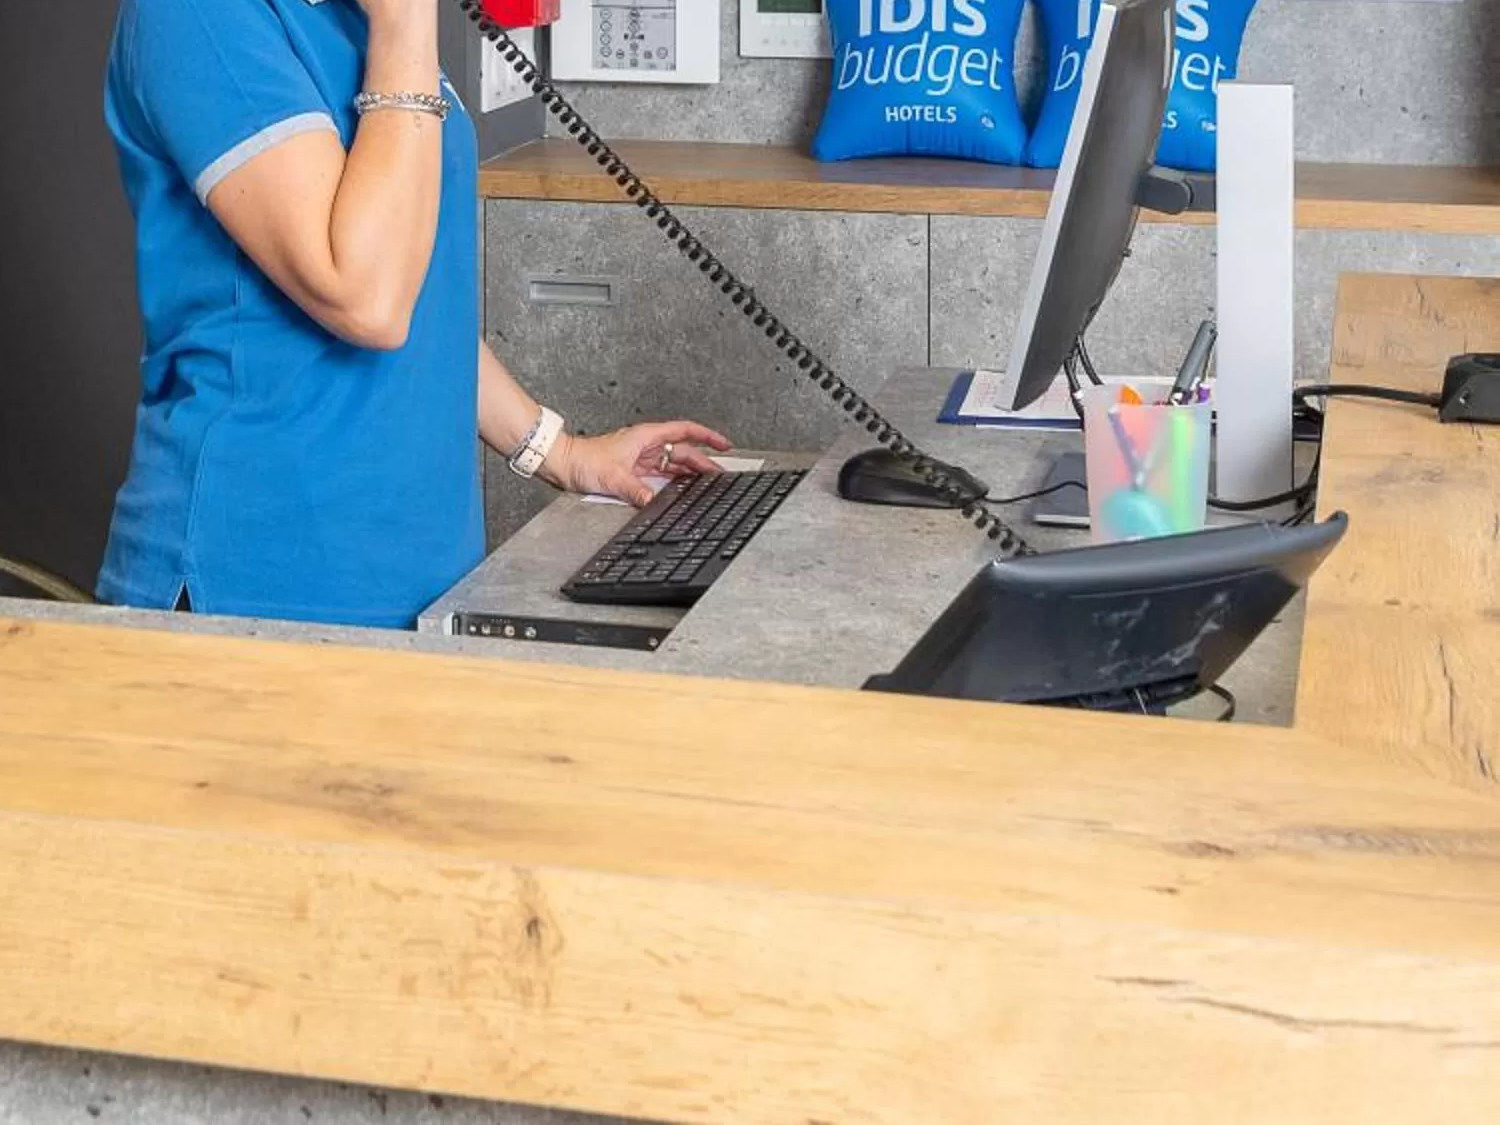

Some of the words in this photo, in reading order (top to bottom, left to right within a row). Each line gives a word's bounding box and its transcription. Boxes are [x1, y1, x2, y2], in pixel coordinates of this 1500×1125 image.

[837, 31, 1003, 96] budget
[1053, 44, 1227, 95] bet
[885, 106, 957, 123] HOTELS
